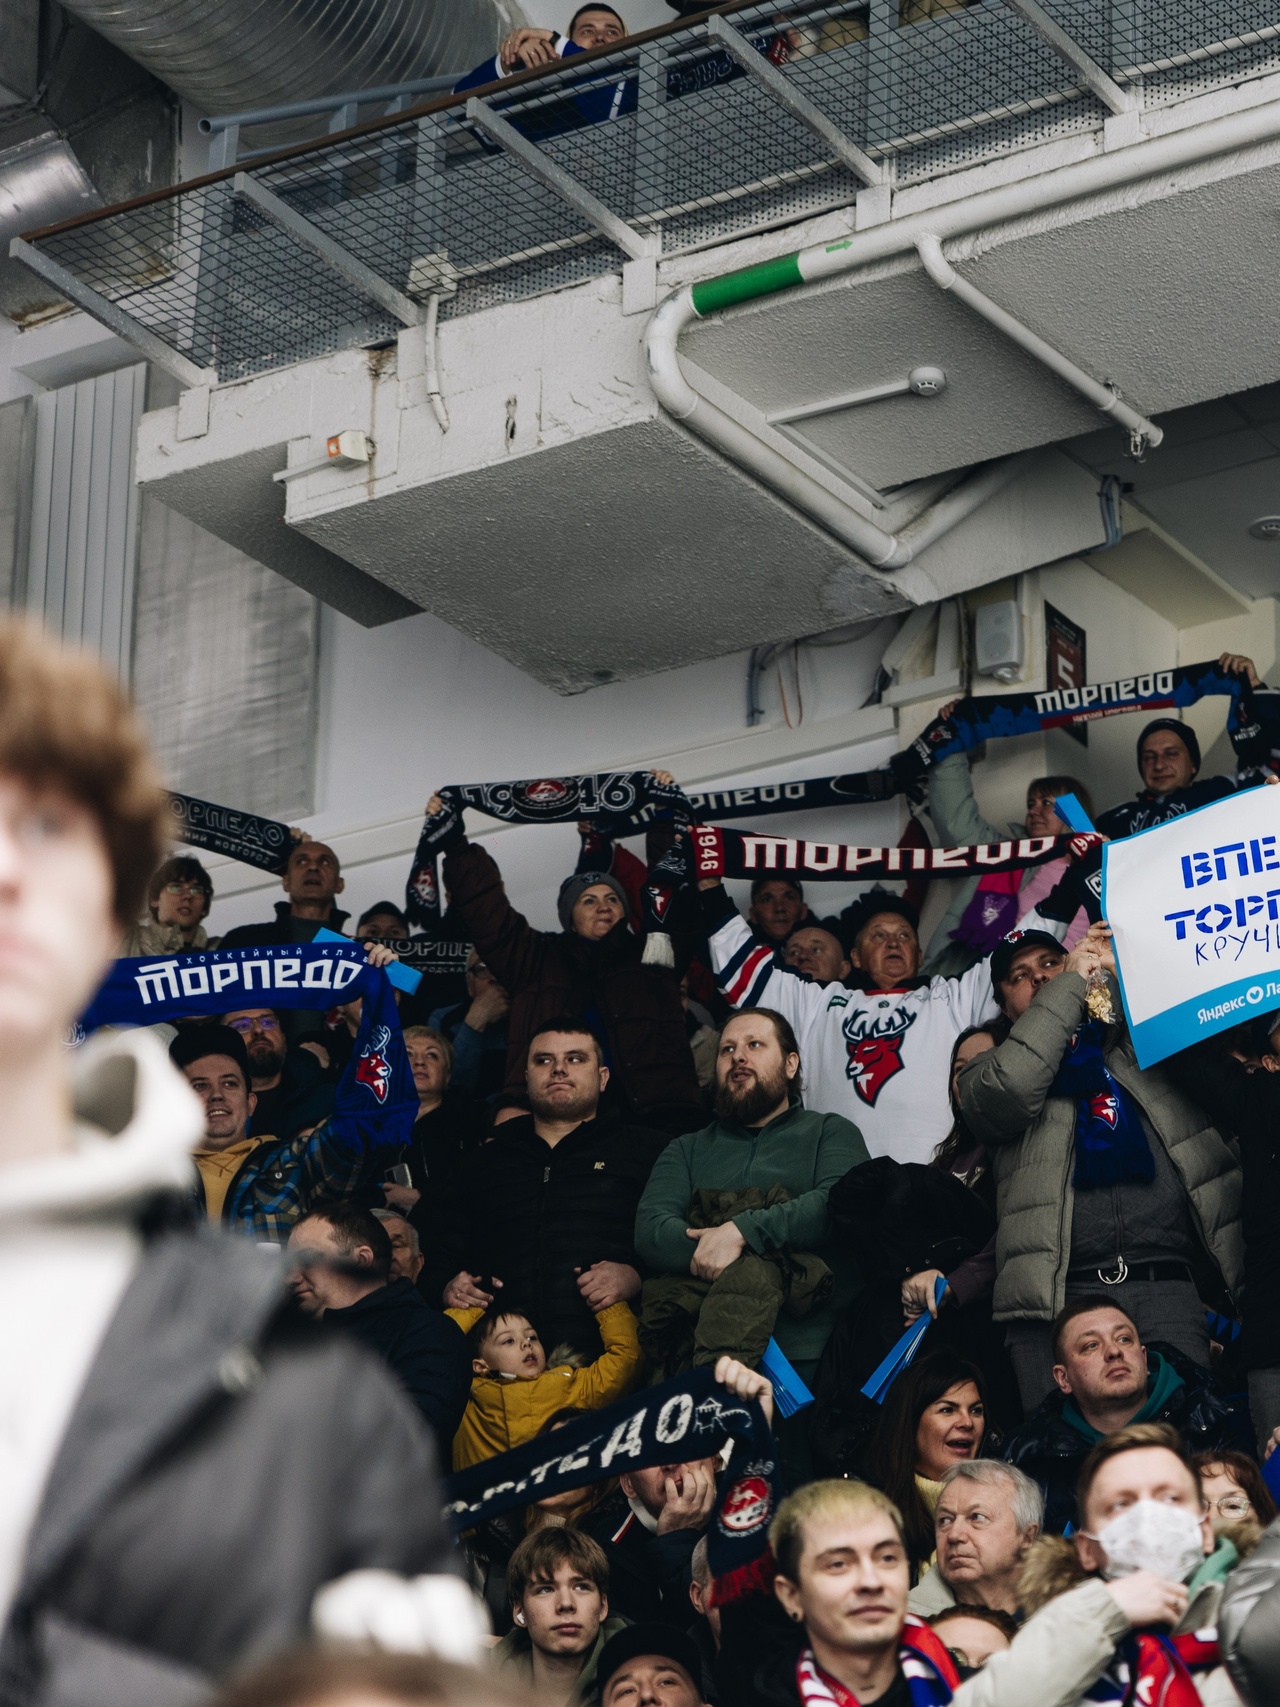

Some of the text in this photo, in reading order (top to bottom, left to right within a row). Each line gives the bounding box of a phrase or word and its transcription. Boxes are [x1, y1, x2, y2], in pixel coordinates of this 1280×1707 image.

[168, 796, 285, 847] ОРПЕДО
[696, 826, 719, 872] 1946
[321, 948, 369, 963] КЛУБ
[388, 940, 476, 957] ОРПЕ
[1197, 996, 1246, 1024] Яндекс
